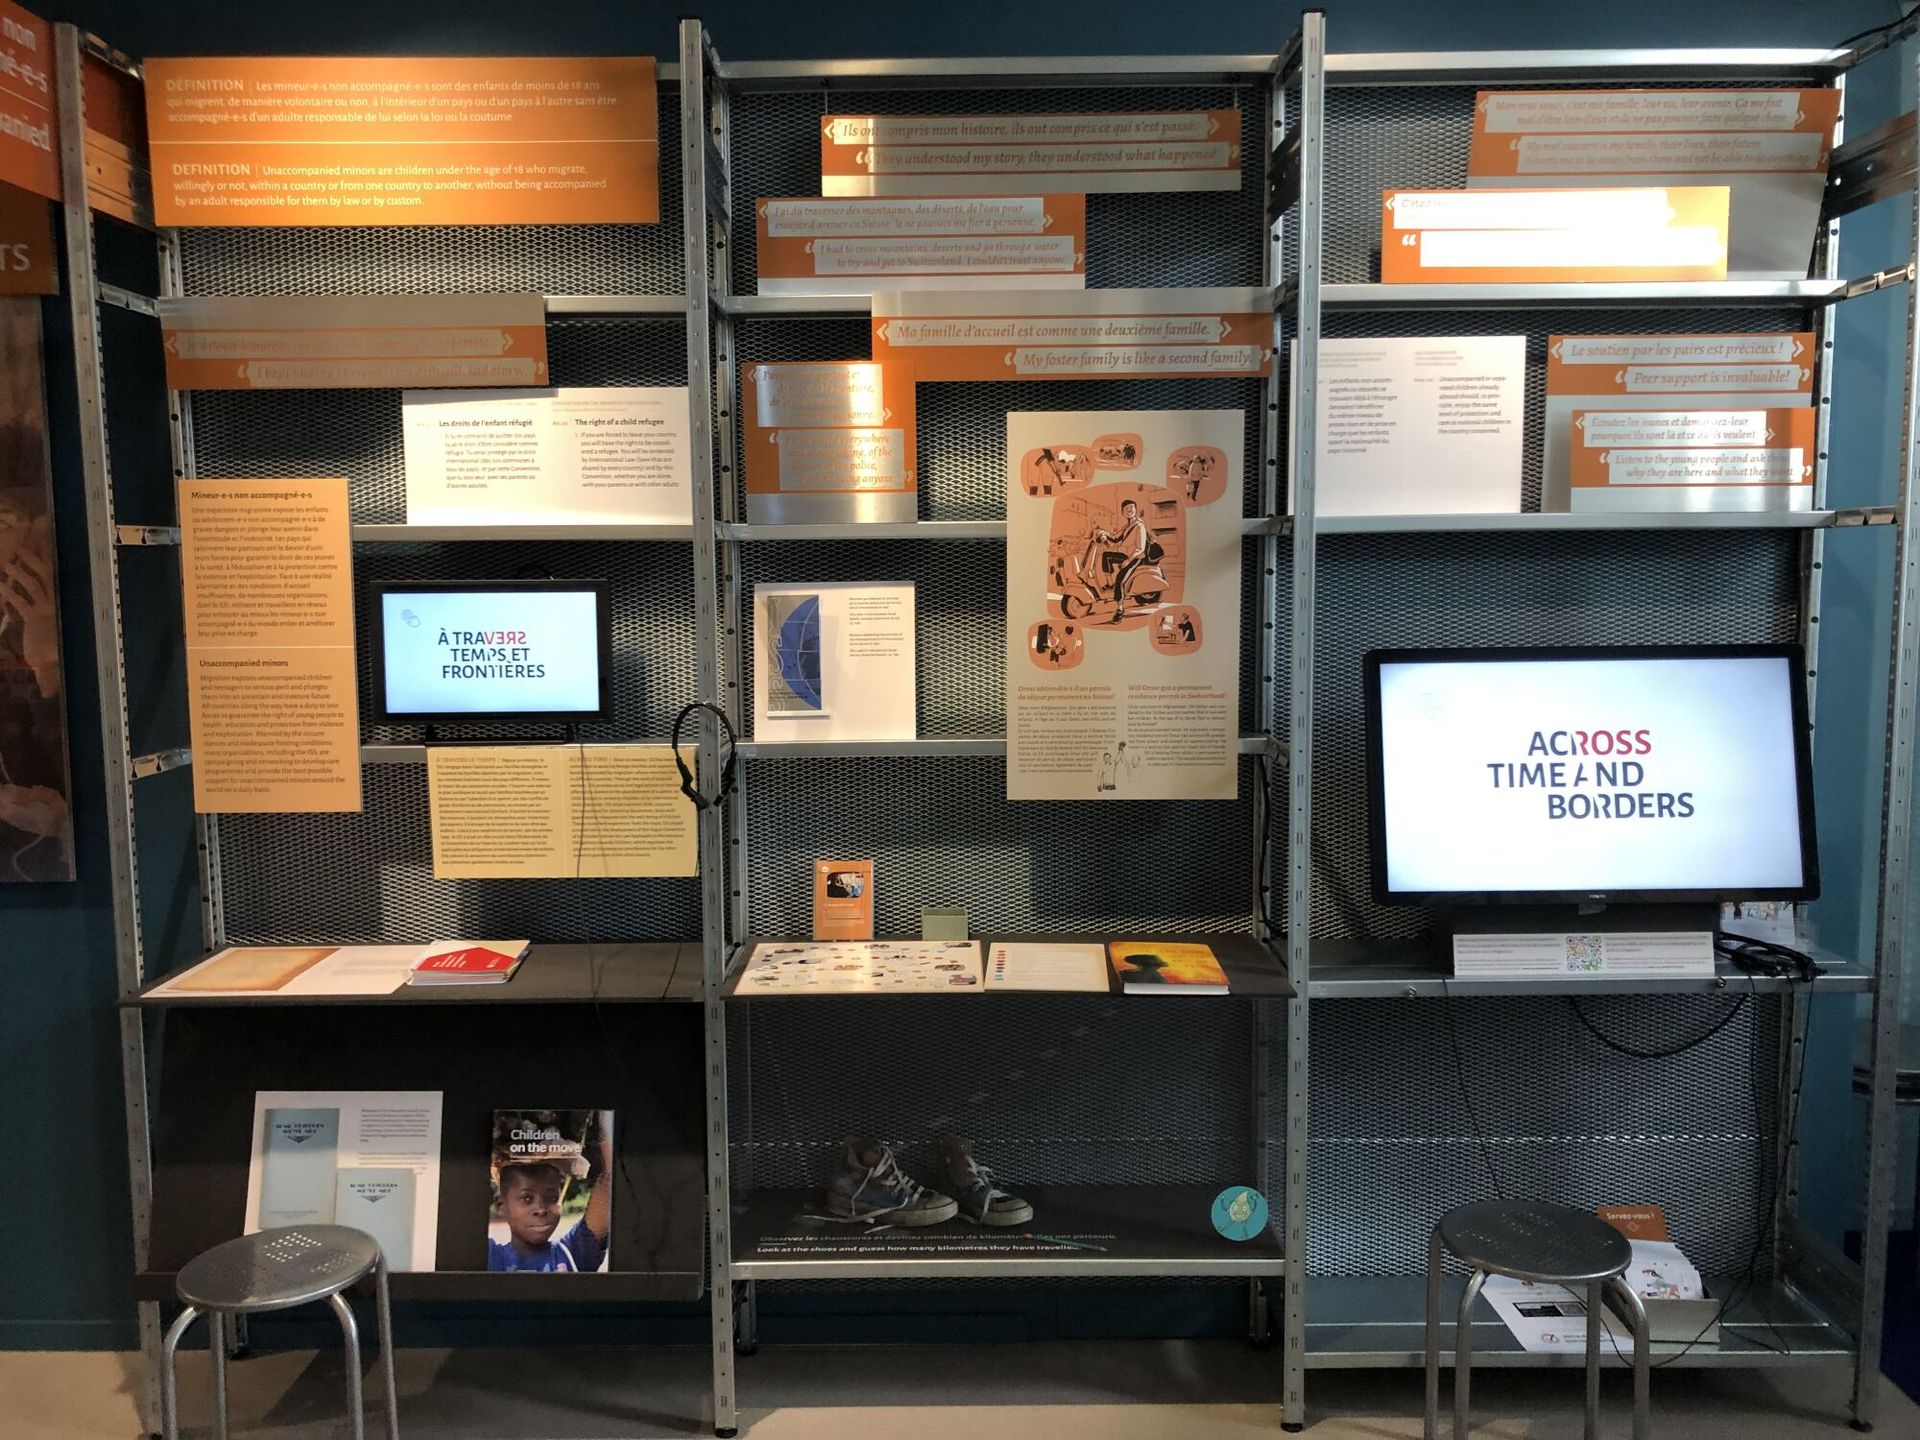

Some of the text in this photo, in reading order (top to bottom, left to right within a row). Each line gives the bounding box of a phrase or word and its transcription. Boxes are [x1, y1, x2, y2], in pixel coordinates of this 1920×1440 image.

[256, 81, 272, 92] Les
[329, 83, 348, 91] non
[432, 80, 452, 91] sont
[454, 80, 471, 91] des
[472, 79, 510, 91] enfants
[510, 79, 524, 90] de
[525, 79, 555, 90] moins
[556, 79, 570, 90] de
[932, 125, 958, 135] mon
[1010, 121, 1026, 134] ils
[1026, 121, 1048, 133] ont
[1050, 120, 1096, 137] compris
[1100, 123, 1110, 132] ce
[1112, 119, 1132, 136] qui
[905, 151, 970, 164] understood
[974, 153, 992, 167] my
[1028, 149, 1054, 166] they
[1056, 148, 1124, 161] understood
[1125, 147, 1156, 160] what
[262, 164, 340, 178] Unaccompanied
[342, 164, 376, 175] minors
[378, 166, 393, 175] are
[394, 164, 434, 175] children
[436, 164, 464, 174] under
[465, 163, 481, 174] the
[484, 166, 500, 177] age
[502, 163, 514, 174] of
[514, 163, 524, 174] 18
[526, 163, 546, 174] who
[174, 180, 214, 194] willingly
[216, 182, 227, 190] or
[249, 179, 280, 190] within
[290, 179, 326, 193] country
[328, 181, 339, 190] or
[340, 179, 363, 190] from
[365, 181, 383, 189] one
[385, 178, 422, 192] country
[423, 178, 432, 189] to
[476, 178, 512, 189] without
[514, 178, 542, 192] being
[543, 177, 606, 191] accompanied
[175, 195, 186, 209] by
[188, 198, 200, 206] an
[202, 195, 228, 206] adult
[230, 195, 285, 209] responsible
[286, 195, 300, 205] for
[302, 195, 328, 205] them
[330, 195, 342, 208] by
[343, 195, 360, 205] law
[362, 197, 372, 205] or
[374, 195, 384, 208] by
[898, 322, 1210, 343] Ma famille d'accueil est comme une deuxième famille.
[1570, 344, 1584, 356] Le
[1587, 343, 1630, 356] soutien
[1632, 346, 1652, 359] par
[1656, 343, 1672, 355] les
[1673, 342, 1704, 359] pairs
[1706, 342, 1723, 354] est
[1023, 354, 1043, 370] My
[1044, 353, 1076, 370] foster
[1080, 352, 1120, 369] family
[1122, 352, 1132, 364] is
[1134, 352, 1156, 364] like
[1168, 351, 1208, 363] second
[1634, 371, 1660, 384] Peer
[1661, 371, 1708, 387] support
[1711, 371, 1720, 383] is
[472, 419, 480, 427] de
[588, 418, 604, 427] right
[638, 418, 664, 427] refugee
[1655, 454, 1670, 463] the
[1730, 453, 1748, 463] and
[1647, 467, 1667, 480] they
[1684, 466, 1704, 476] here
[1704, 466, 1722, 476] and
[1724, 466, 1748, 476] what
[450, 647, 530, 662] TEMPS ET
[199, 659, 261, 668] Unaccompanied
[442, 660, 545, 679] FRONTIÈRES
[1528, 729, 1652, 756] ACROSS
[1487, 761, 1644, 788] TIME AND
[1547, 792, 1695, 819] BORDERS
[510, 1129, 560, 1140] Children
[510, 1142, 582, 1153] on the move
[990, 1244, 1010, 1252] they
